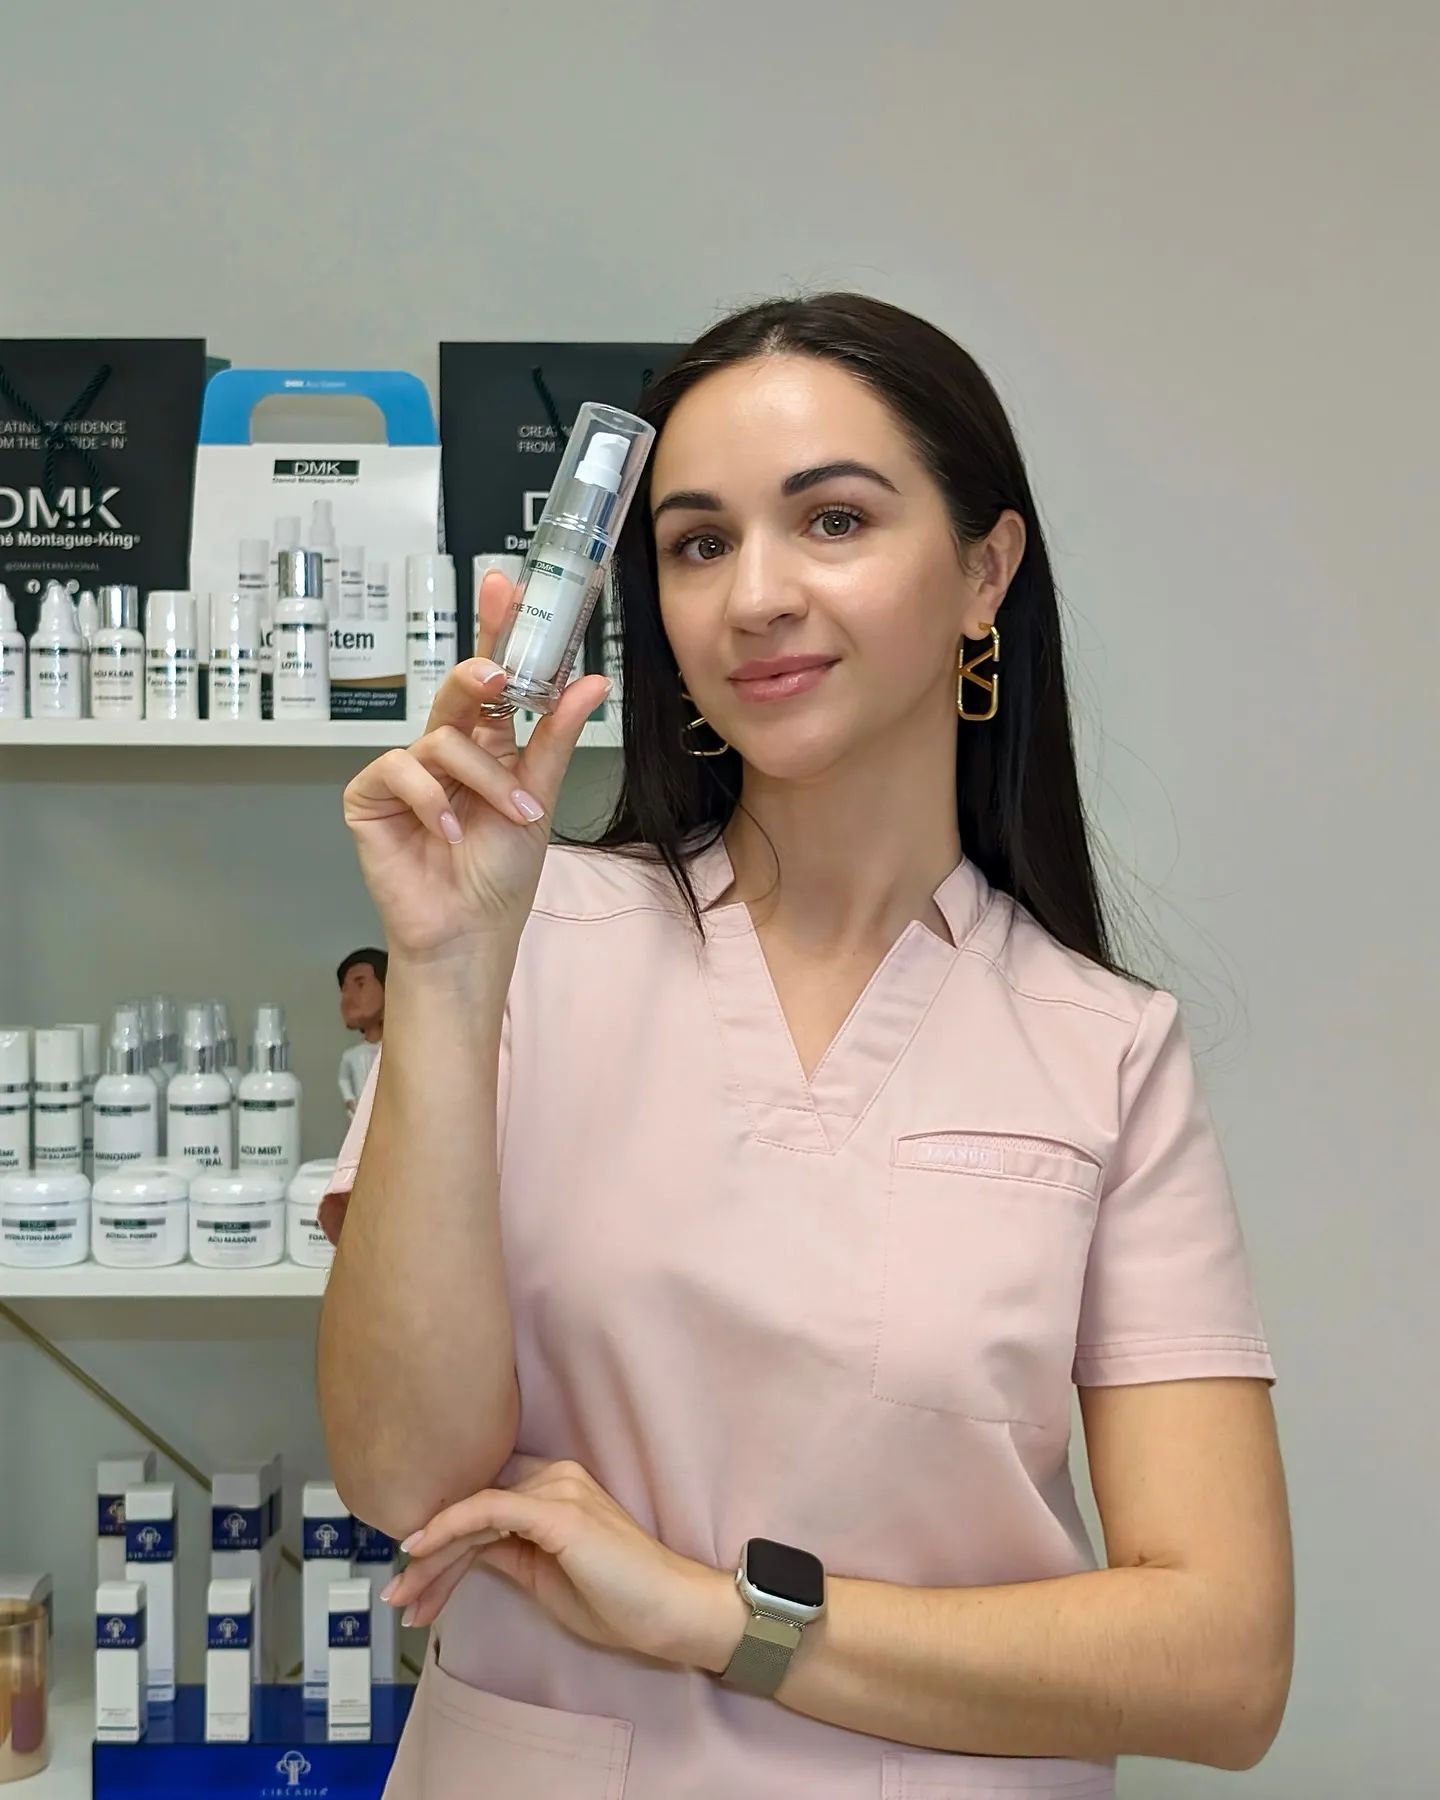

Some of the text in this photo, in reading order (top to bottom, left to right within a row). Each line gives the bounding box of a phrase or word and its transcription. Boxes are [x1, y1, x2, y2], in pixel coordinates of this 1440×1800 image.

[19, 436, 41, 450] THE
[518, 440, 556, 454] FROM
[293, 461, 340, 476] DMK
[535, 561, 555, 572] DMK
[526, 605, 554, 622] TONE
[329, 629, 375, 650] tem
[412, 659, 427, 667] RED
[183, 1145, 211, 1156] HERB
[257, 1145, 283, 1156] MIST
